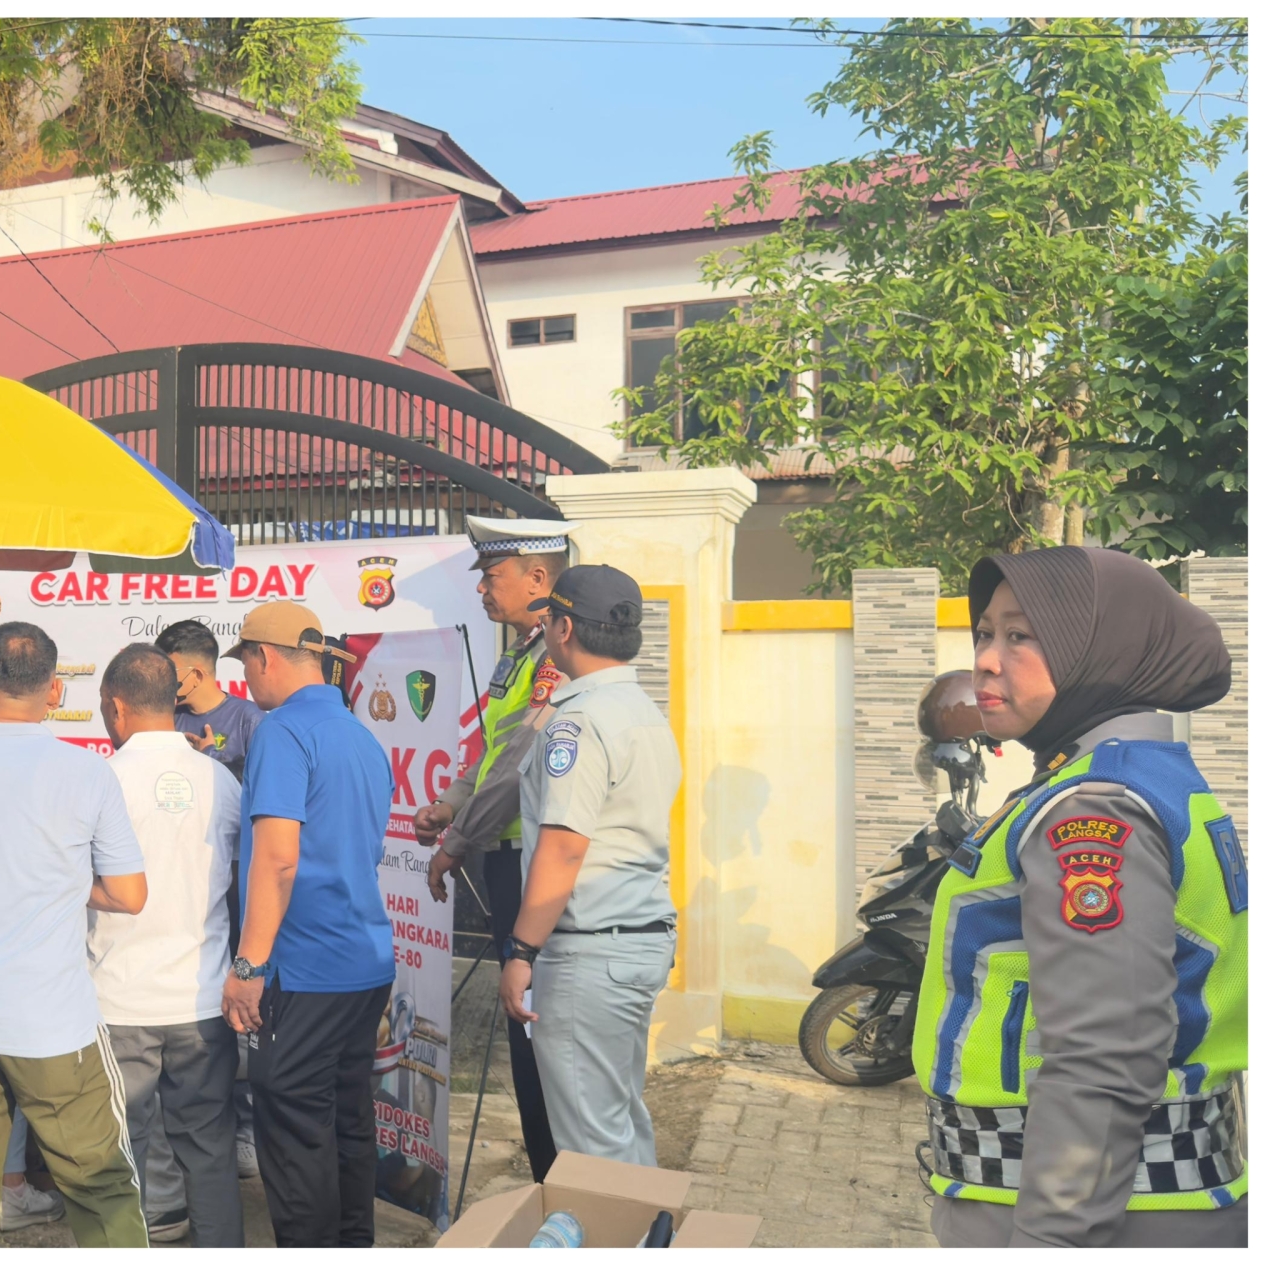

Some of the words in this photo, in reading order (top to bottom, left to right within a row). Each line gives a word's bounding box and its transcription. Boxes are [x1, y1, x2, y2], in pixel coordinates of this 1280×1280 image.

[360, 557, 395, 567] ACEH
[29, 570, 110, 602] CAR
[120, 573, 218, 601] FREE
[229, 564, 316, 598] DAY
[121, 615, 170, 637] Dala
[391, 746, 452, 807] KG
[385, 819, 416, 834] SEHATA
[1056, 820, 1119, 837] POLRES
[1059, 829, 1112, 842] LANGSA
[1069, 853, 1112, 867] ACEH
[386, 892, 419, 917] HARI
[869, 912, 898, 923] HONDA
[393, 944, 423, 970] E-80
[404, 1036, 438, 1068] POLRI
[372, 1097, 431, 1140] SIDOKES
[400, 1132, 447, 1177] LANGSA
